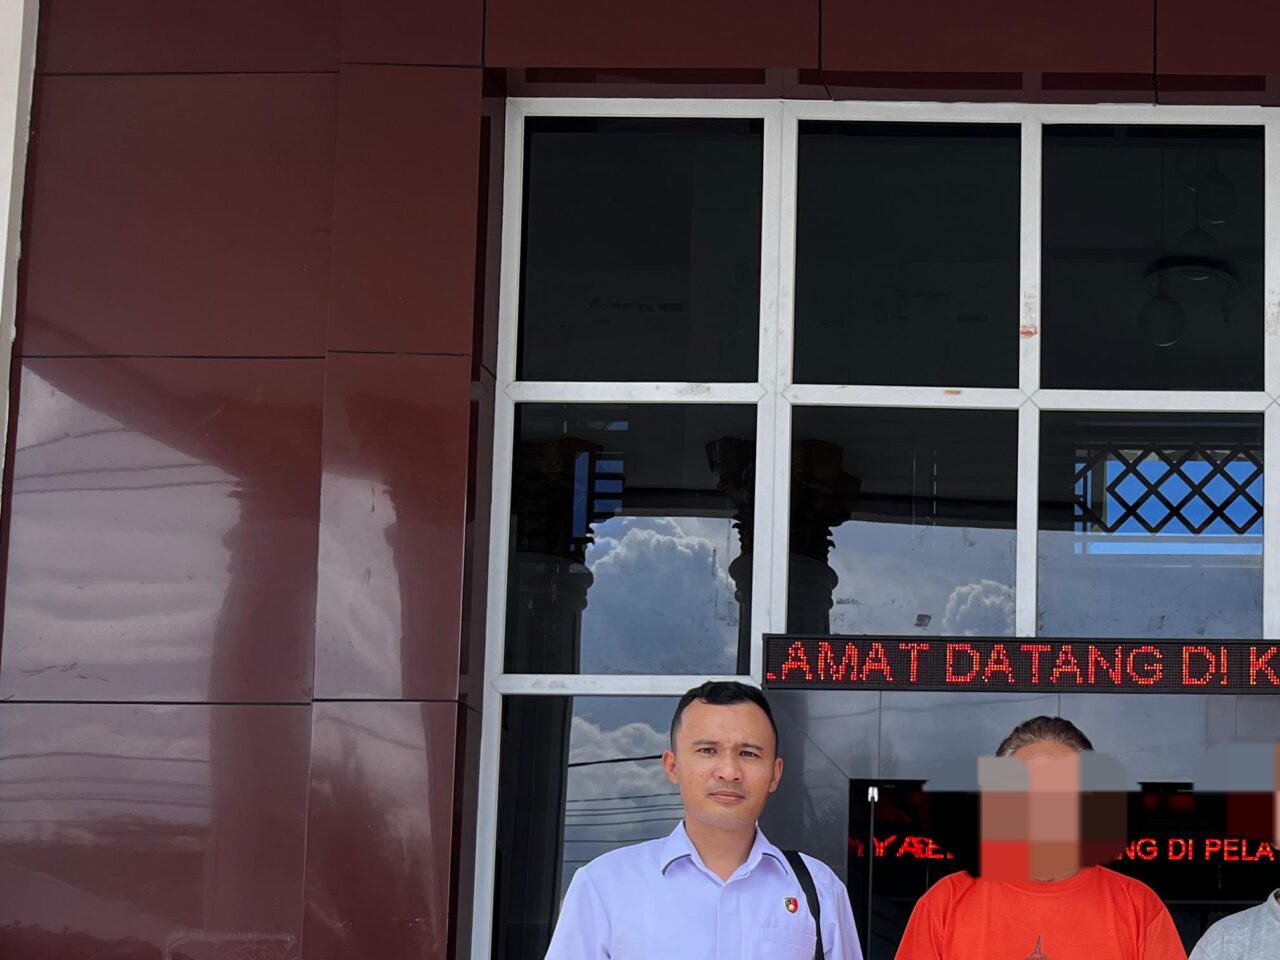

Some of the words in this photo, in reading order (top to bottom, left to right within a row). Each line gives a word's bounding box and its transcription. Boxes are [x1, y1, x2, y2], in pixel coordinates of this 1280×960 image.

[766, 641, 931, 683] AMAT
[946, 643, 1164, 685] DATANG
[1182, 645, 1228, 686] DI
[1168, 838, 1193, 860] DI
